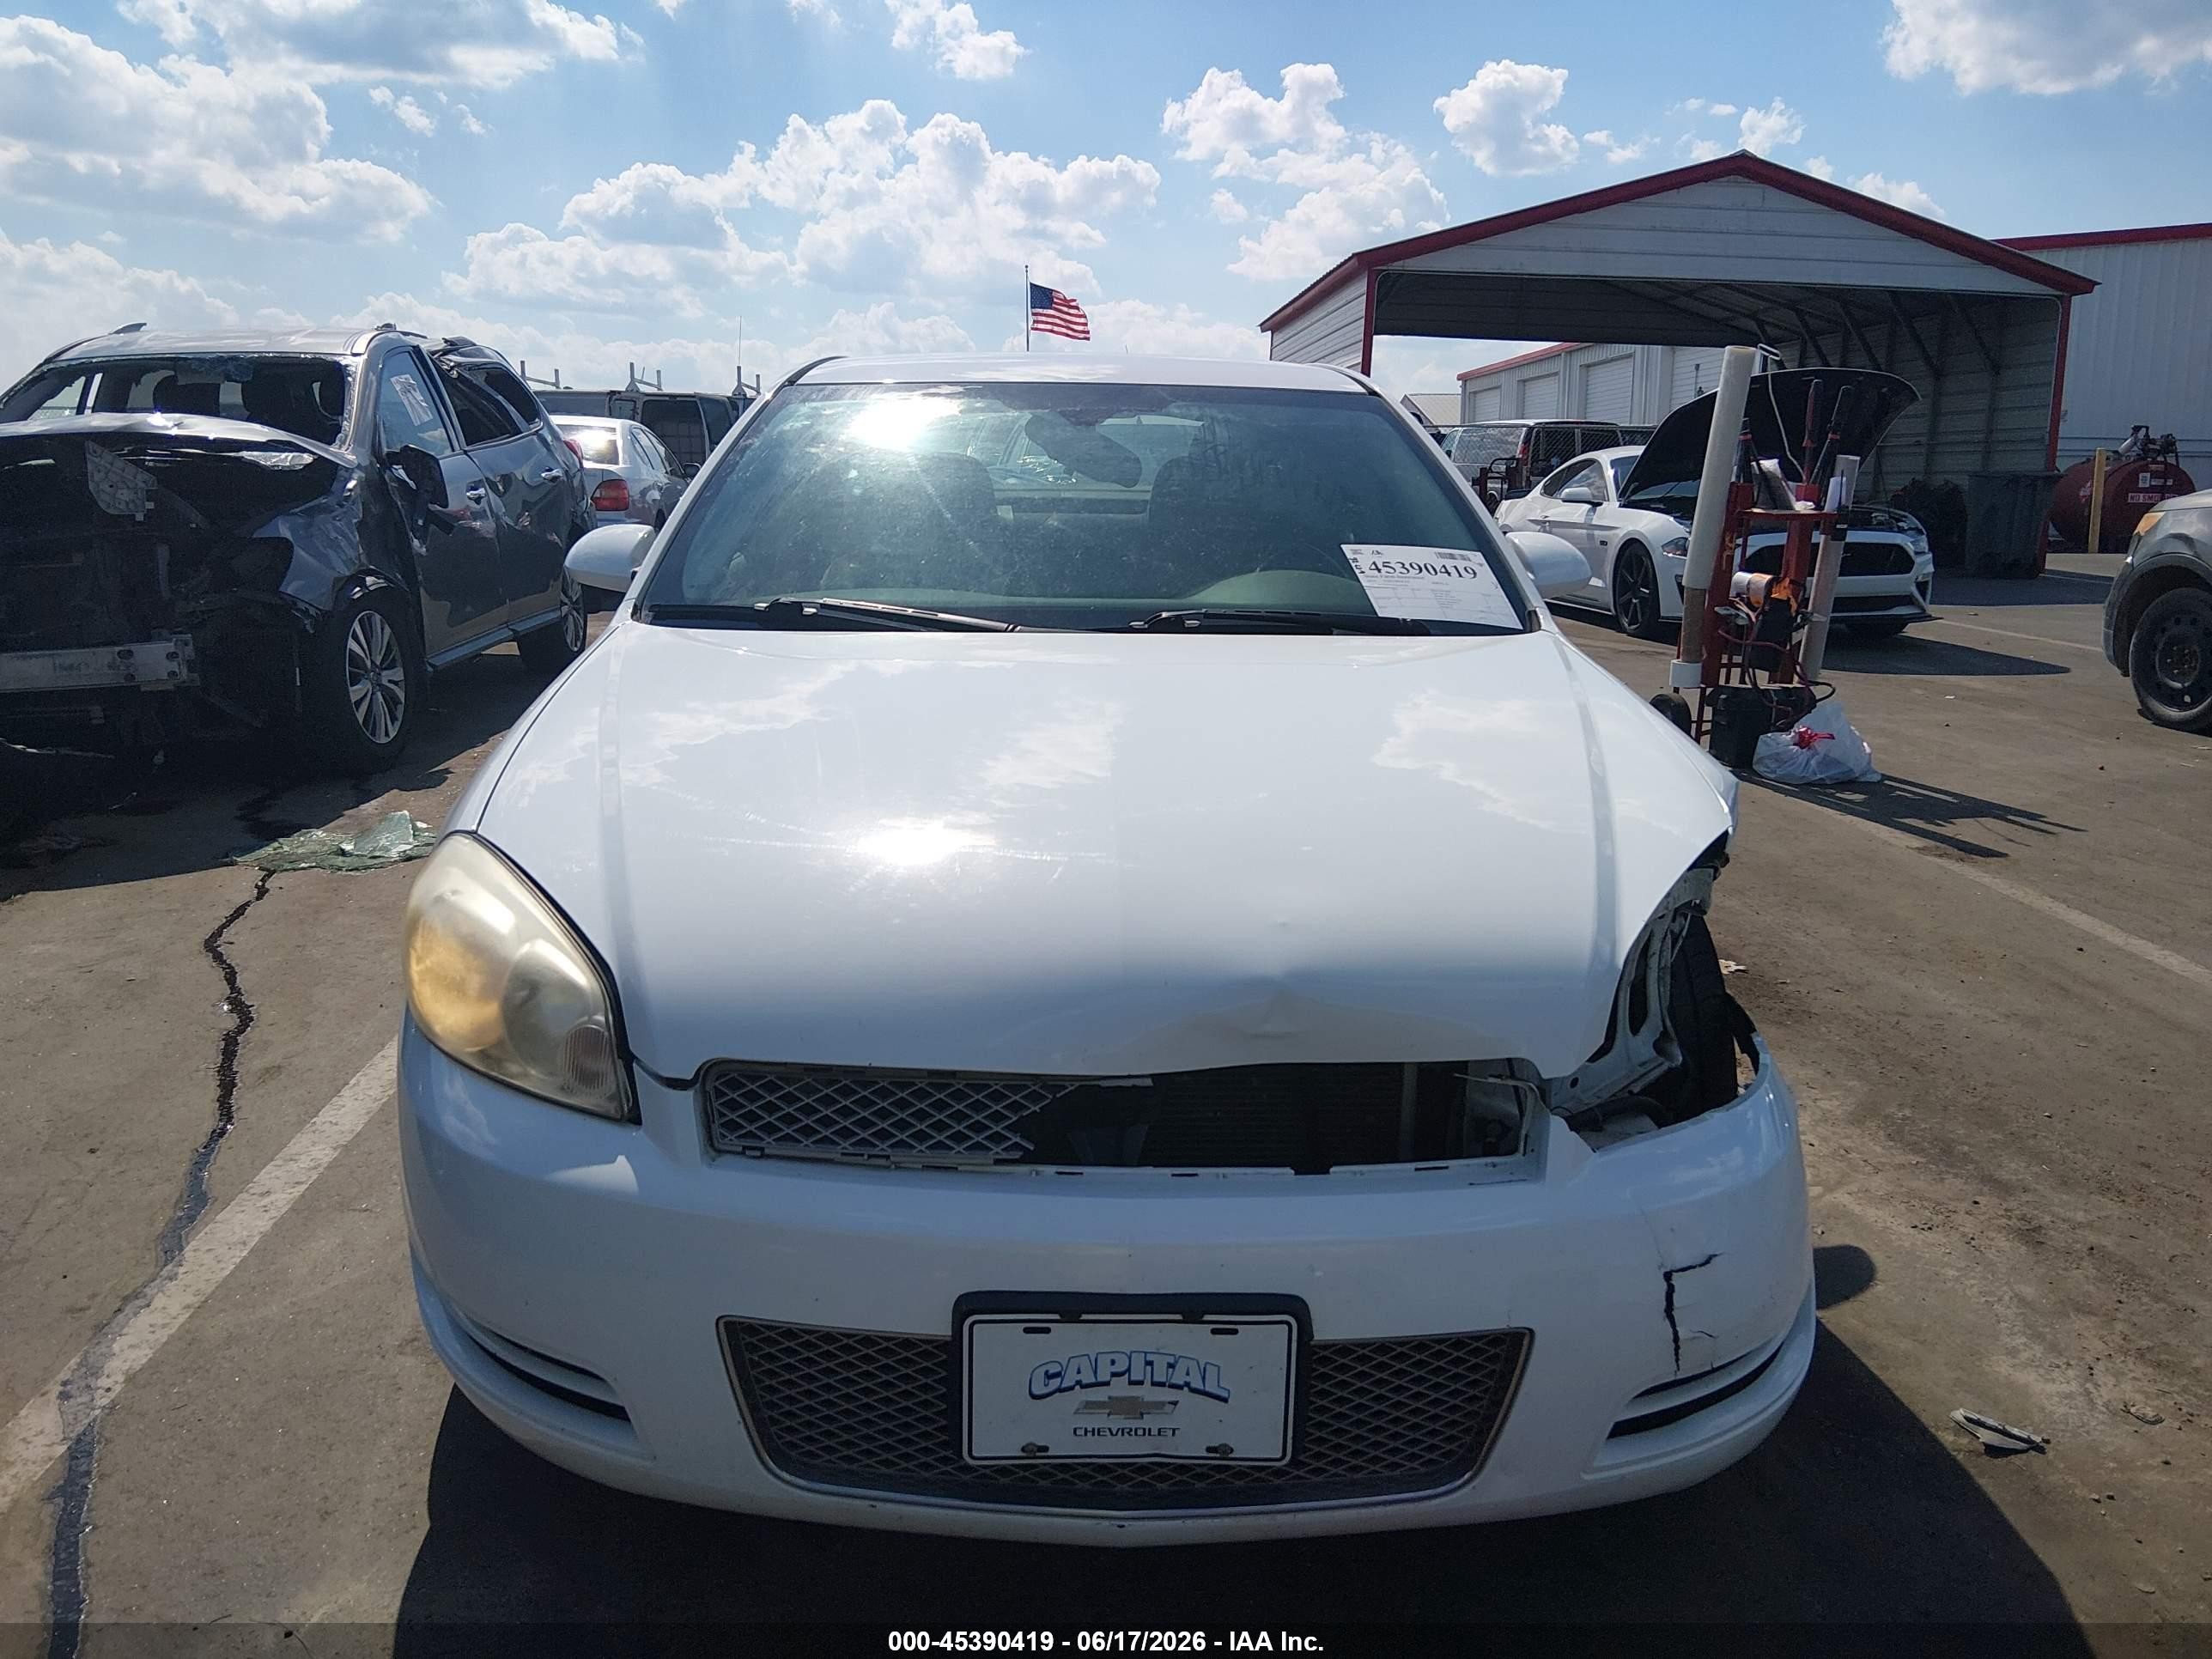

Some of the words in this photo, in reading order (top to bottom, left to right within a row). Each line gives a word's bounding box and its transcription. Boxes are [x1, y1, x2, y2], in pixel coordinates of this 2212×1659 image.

[2130, 494, 2140, 502] NO
[1368, 560, 1478, 580] 45390419
[1029, 1351, 1230, 1403] CAPITAL
[1073, 1426, 1181, 1437] CHEVROLET
